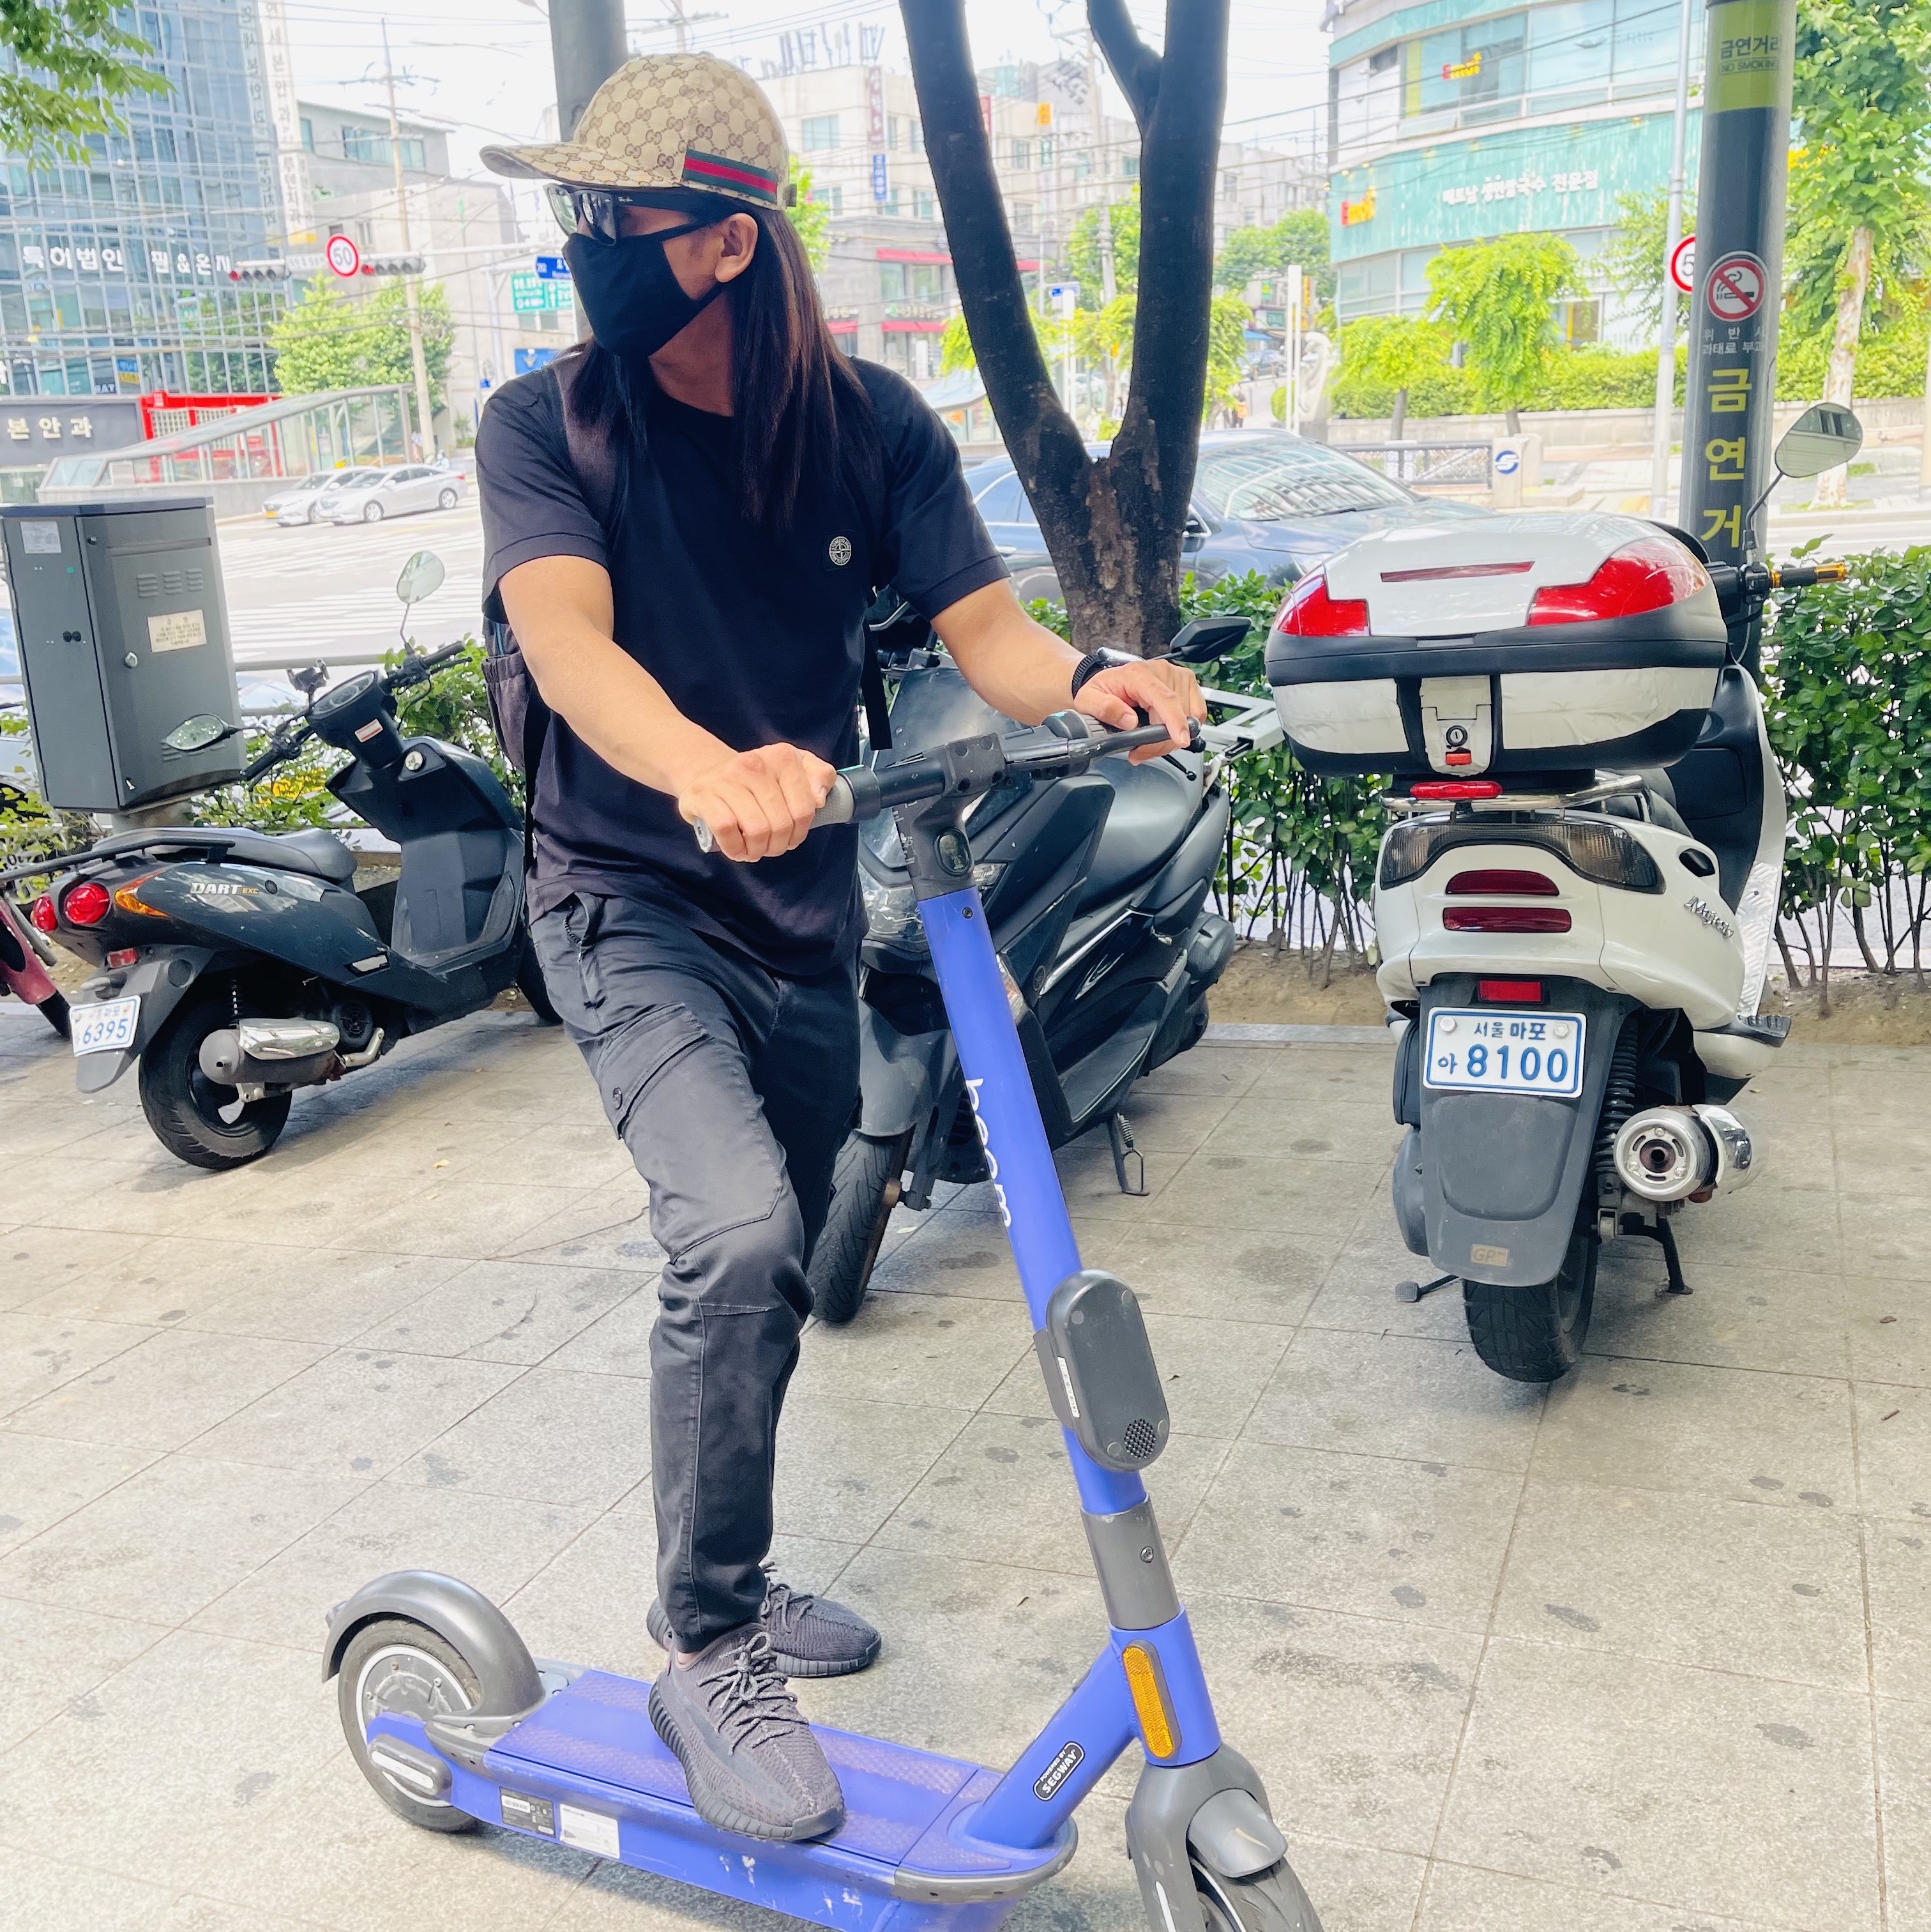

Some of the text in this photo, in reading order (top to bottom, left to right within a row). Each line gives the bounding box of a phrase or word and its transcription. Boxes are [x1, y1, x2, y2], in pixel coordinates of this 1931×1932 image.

[1552, 169, 1598, 193] 전문점
[22, 246, 124, 271] 특허법인
[333, 247, 352, 266] 50
[1681, 254, 1695, 277] 5
[1702, 342, 1738, 356] 과태료
[190, 882, 243, 895] DART
[83, 1018, 128, 1045] 6395
[1474, 1022, 1547, 1041] 서울 마포
[1437, 1044, 1569, 1083] 아 8100
[1041, 1749, 1077, 1794] SEGWAY
